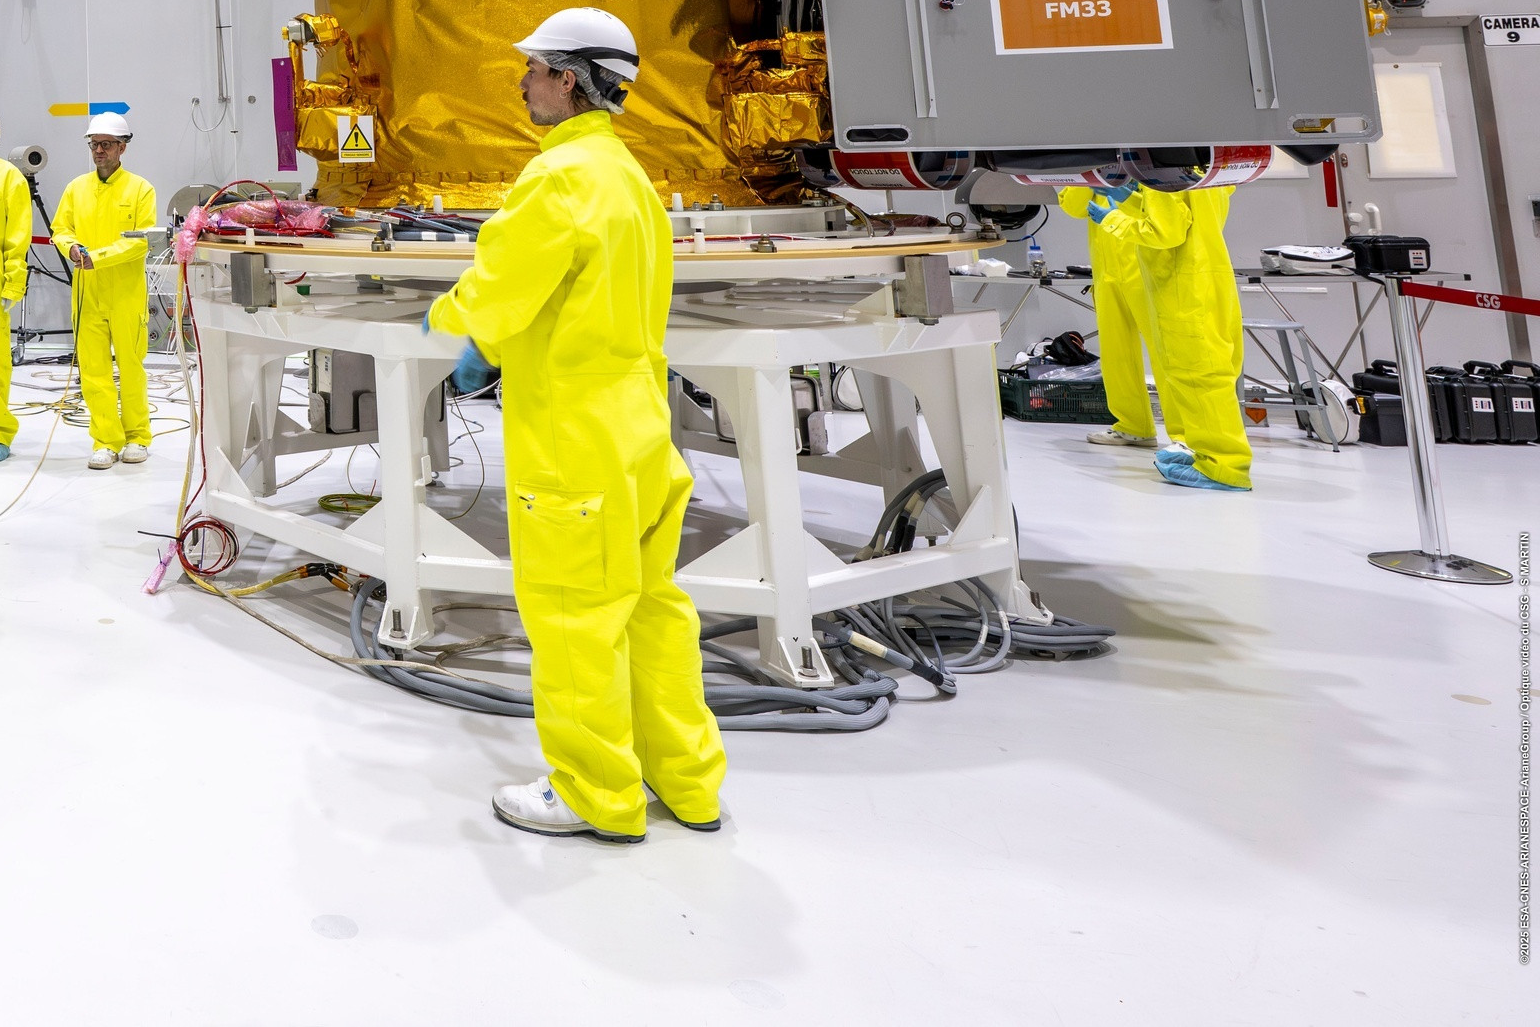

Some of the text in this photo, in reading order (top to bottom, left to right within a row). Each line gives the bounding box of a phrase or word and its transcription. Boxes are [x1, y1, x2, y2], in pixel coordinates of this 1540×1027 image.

[1045, 0, 1112, 19] FM33
[1483, 17, 1540, 30] CAMERA
[1506, 31, 1520, 43] 9
[1475, 293, 1501, 309] CSG
